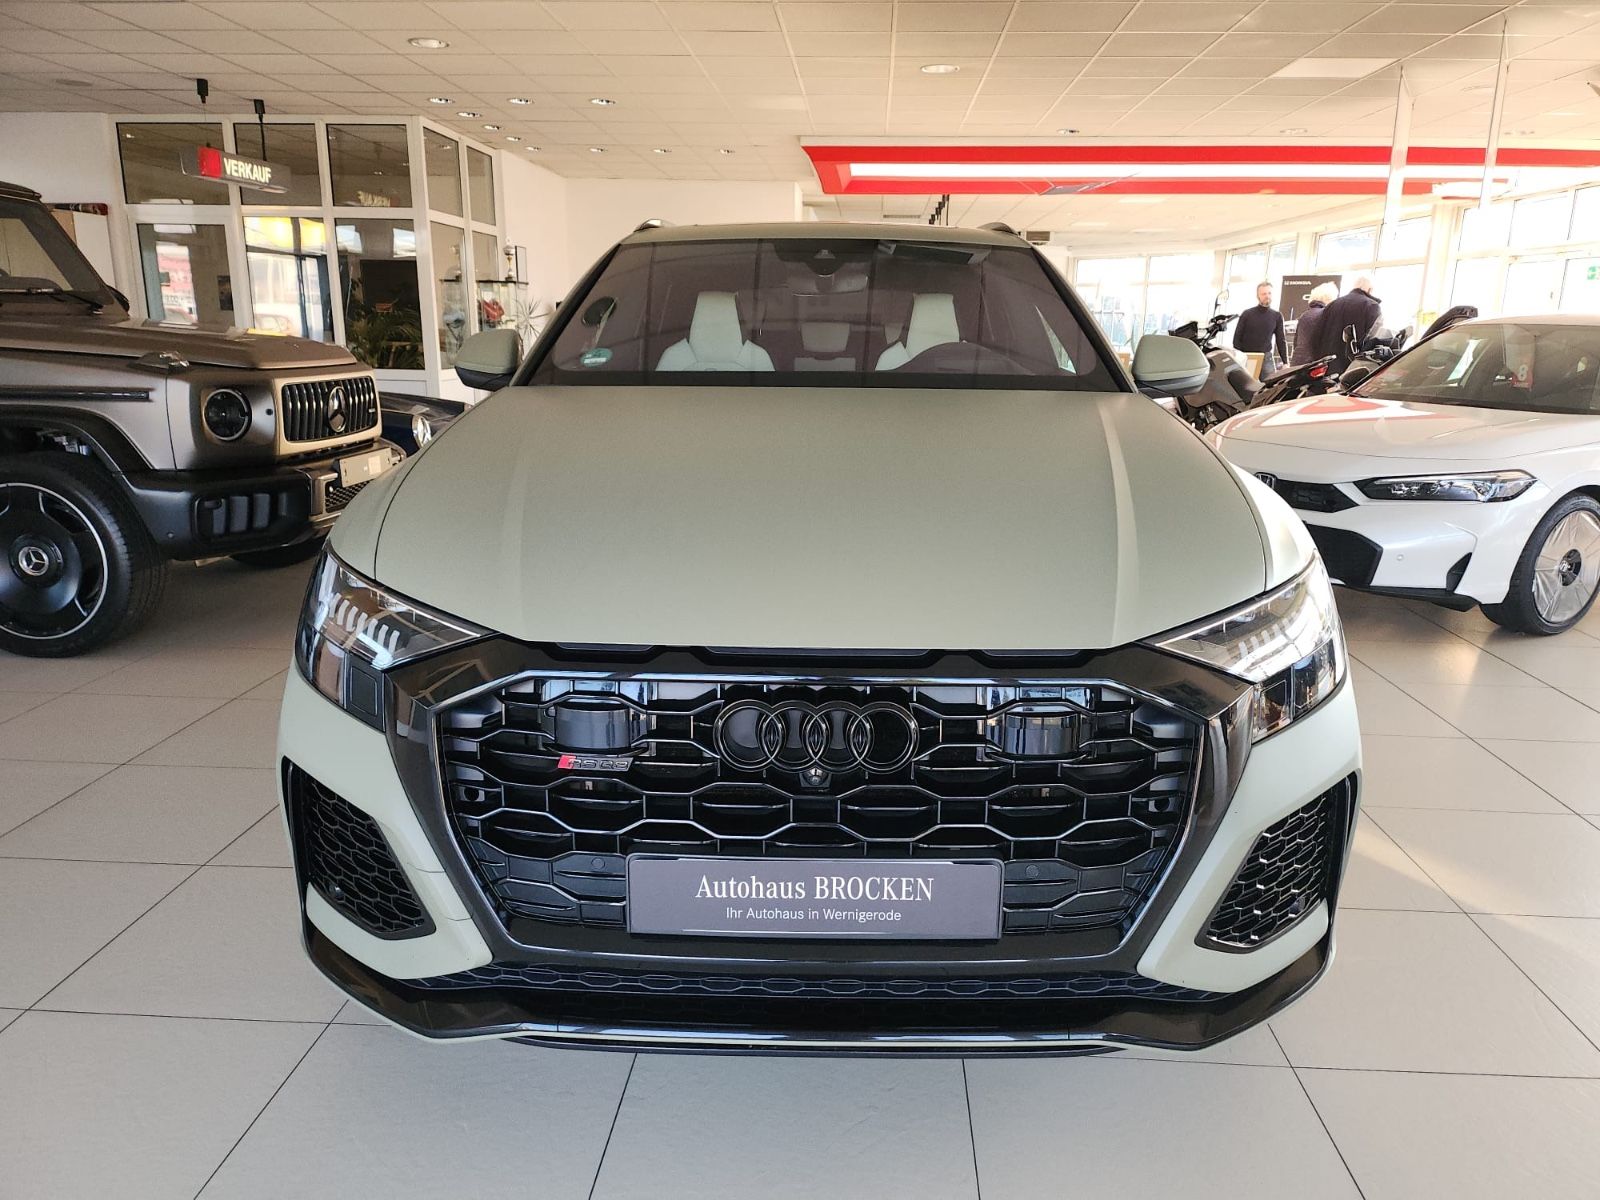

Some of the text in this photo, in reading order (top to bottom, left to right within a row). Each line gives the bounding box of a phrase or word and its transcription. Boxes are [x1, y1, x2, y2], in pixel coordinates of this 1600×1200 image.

[223, 157, 272, 184] VERKAUF
[695, 875, 934, 901] Autohaus BROCKEN
[726, 907, 902, 923] Ihr Autohaus in Wernigerode
